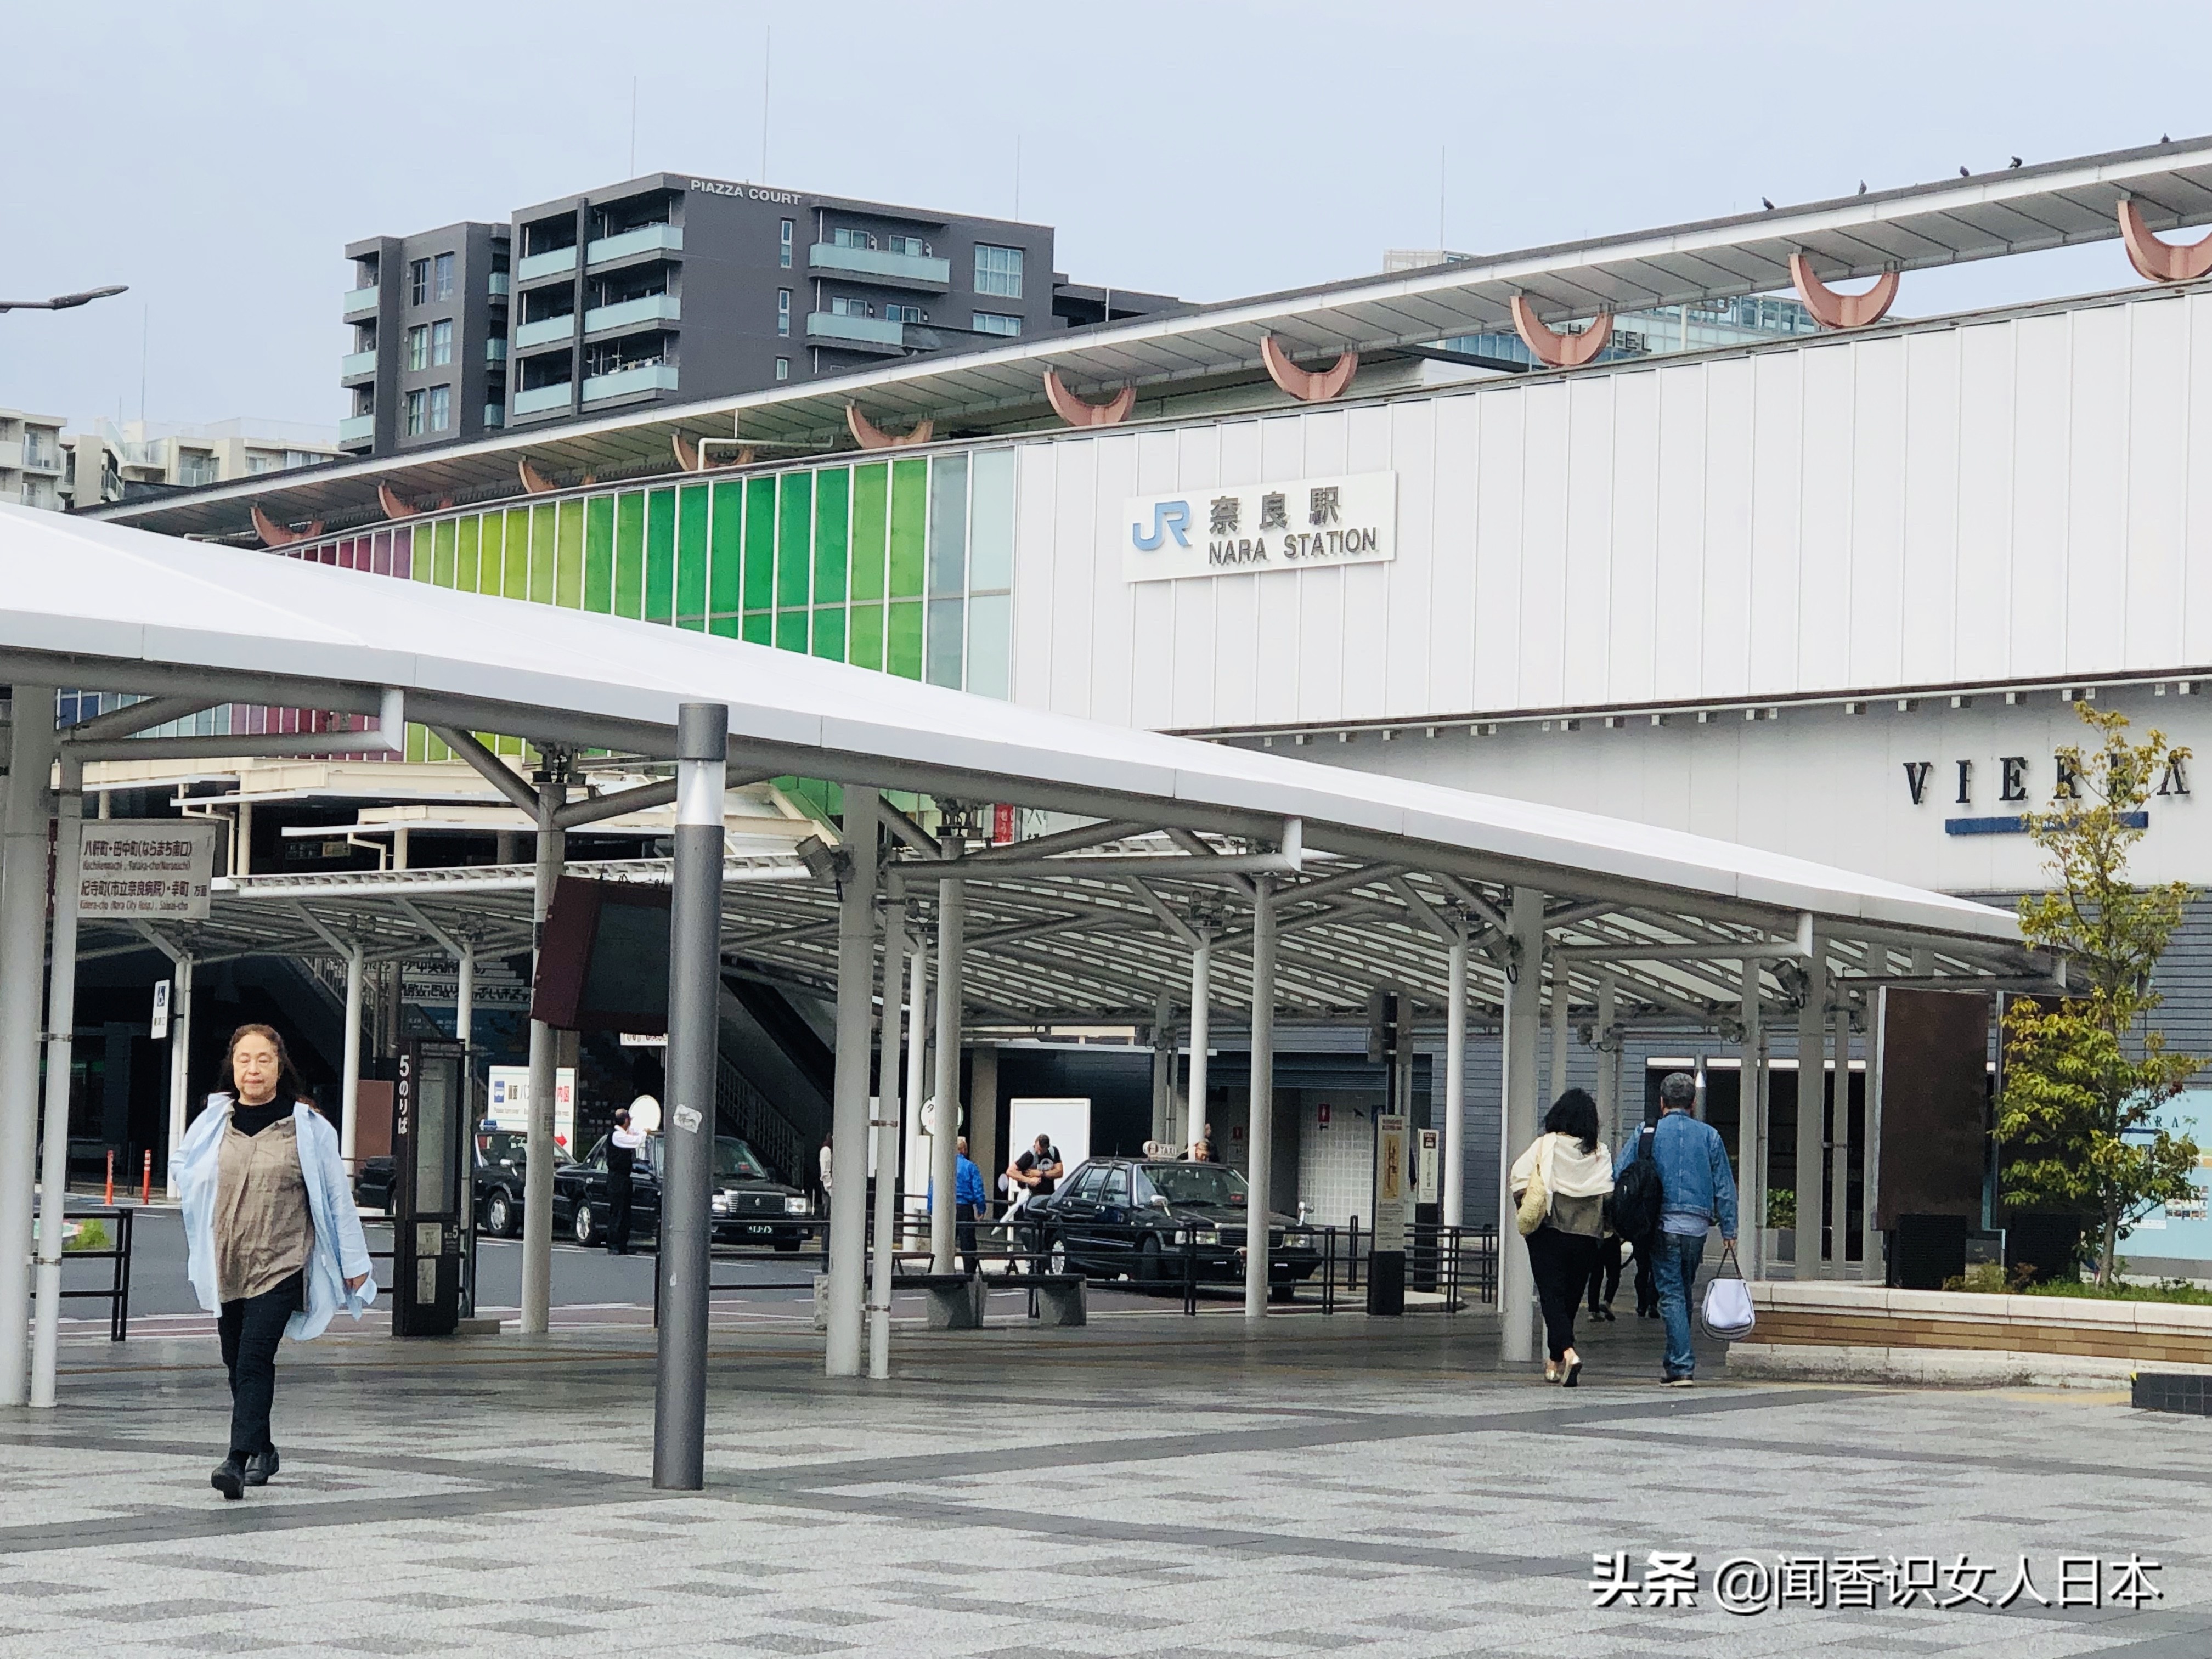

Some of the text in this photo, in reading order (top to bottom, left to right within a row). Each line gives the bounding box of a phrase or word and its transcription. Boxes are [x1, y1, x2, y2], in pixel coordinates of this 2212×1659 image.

[691, 179, 802, 205] PIAZZA COURT
[1132, 500, 1192, 550] JR
[1209, 486, 1341, 535] 奈良駅
[1209, 528, 1377, 565] NARA STATION
